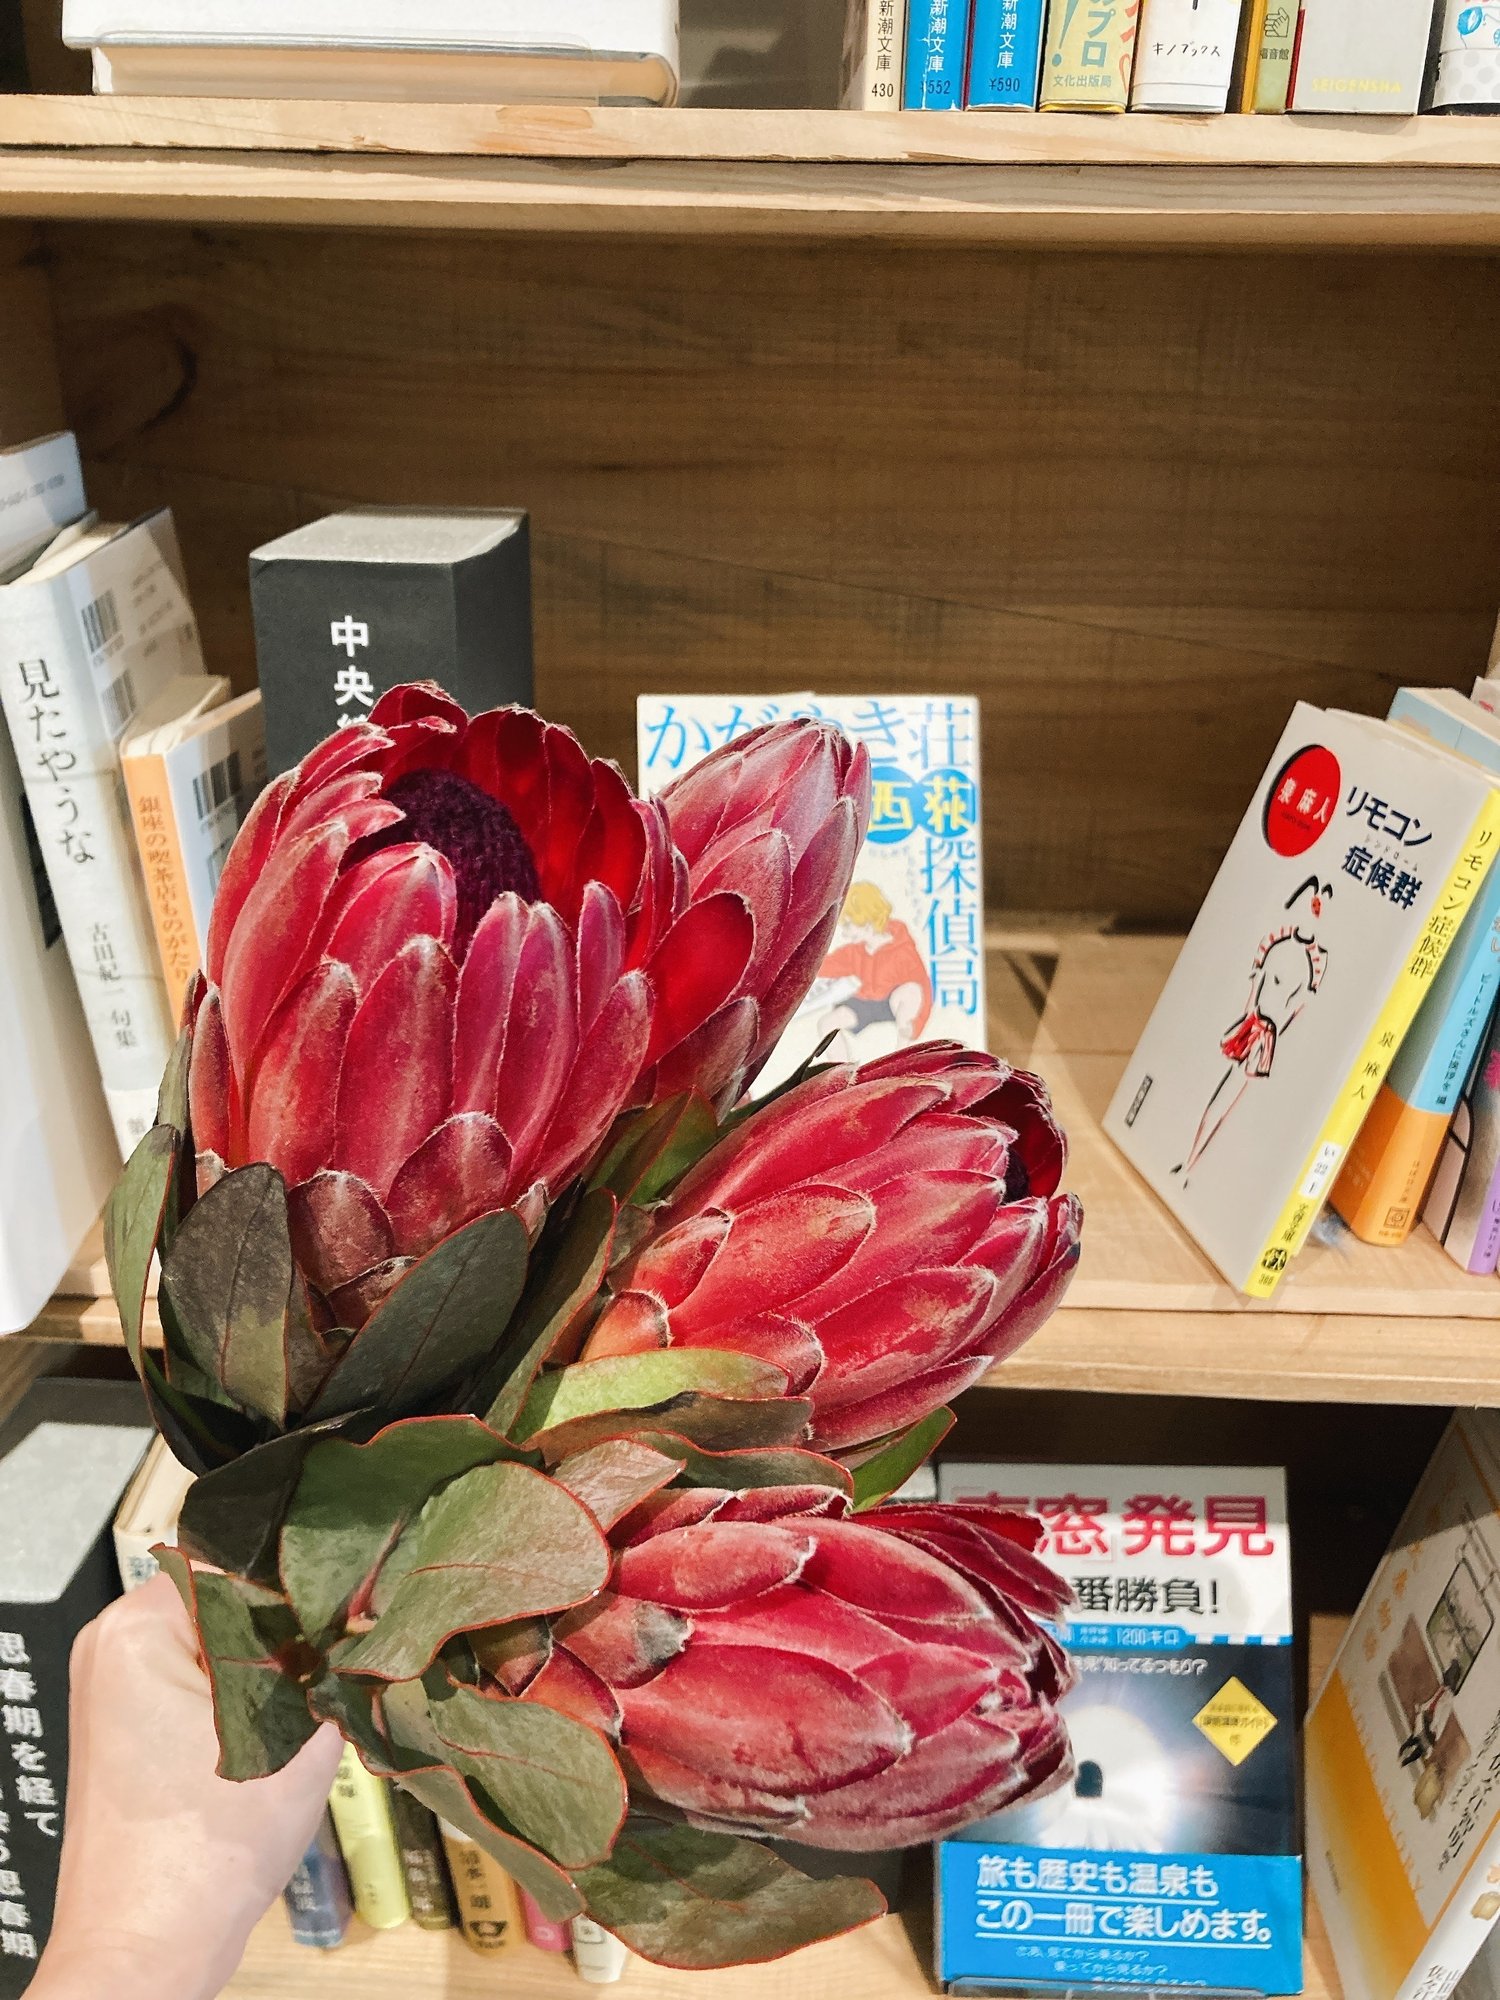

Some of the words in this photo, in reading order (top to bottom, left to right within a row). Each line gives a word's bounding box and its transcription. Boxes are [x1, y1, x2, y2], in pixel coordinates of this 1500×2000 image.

[875, 0, 894, 71] 新潮文庫
[927, 0, 948, 73] 新潮文庫
[1152, 42, 1222, 58] キノブックス
[871, 83, 894, 98] 430
[989, 78, 1021, 93] ¥590
[1052, 74, 1112, 89] 文化出版局
[1311, 77, 1403, 94] SEIGENSHA
[331, 615, 374, 728] 中央
[18, 658, 96, 865] 見たやうな
[1345, 786, 1433, 848] リモコン
[1341, 845, 1423, 911] 症候群
[920, 837, 979, 1015] 探偵局
[977, 1855, 1219, 1899] 旅も歴史も温泉も
[976, 1899, 1273, 1943] この一冊で楽しめます。
